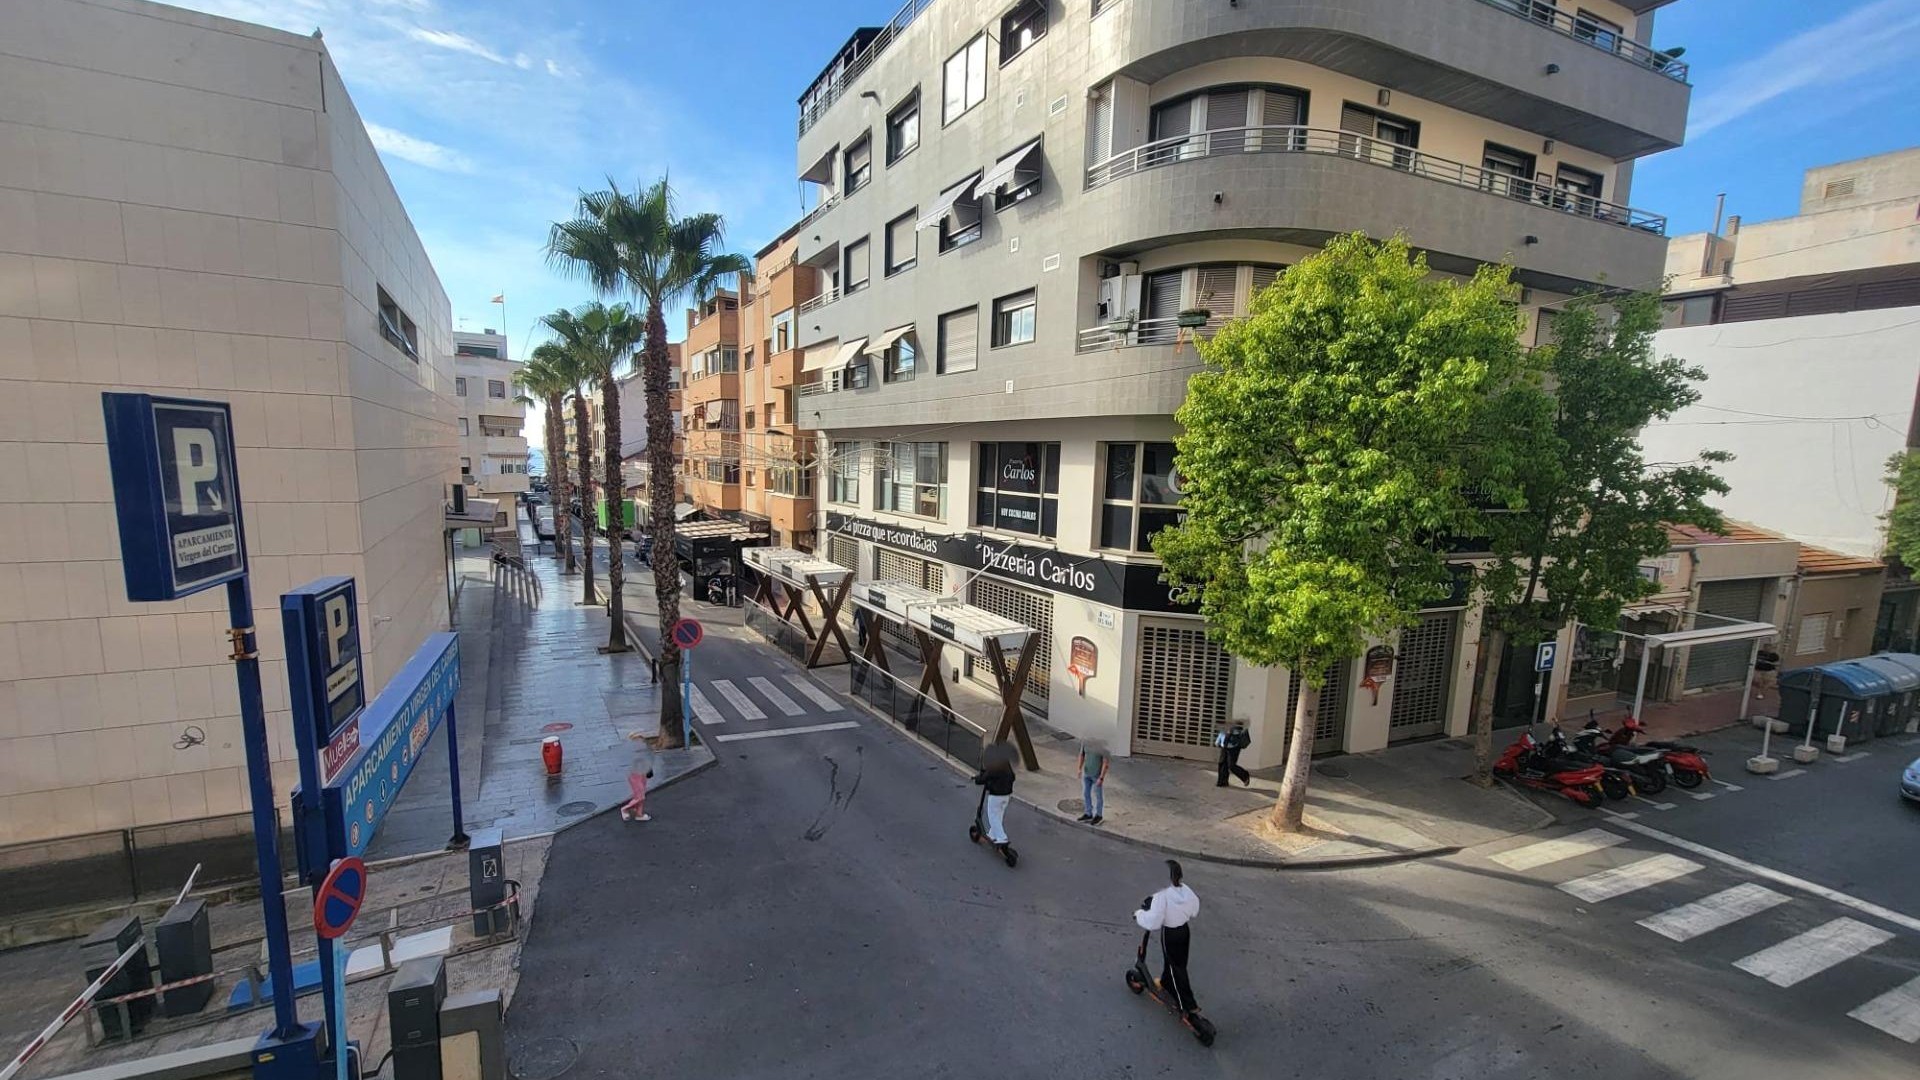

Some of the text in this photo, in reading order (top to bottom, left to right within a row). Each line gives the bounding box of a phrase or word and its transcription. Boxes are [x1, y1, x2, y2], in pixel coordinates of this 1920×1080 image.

[172, 427, 218, 516] P
[1004, 464, 1035, 480] Carlos
[178, 529, 233, 548] APARCAMIENTO
[853, 520, 871, 536] pizza
[872, 525, 886, 542] que
[887, 530, 938, 553] recordabas
[178, 551, 201, 564] Virgen
[202, 545, 212, 557] del
[982, 544, 1095, 591] Pizzería Carlos
[325, 594, 349, 668] P
[1541, 646, 1553, 668] P
[345, 707, 410, 812] APARCAMIENTO
[410, 678, 431, 717] VIRGEN
[431, 667, 442, 689] DEL
